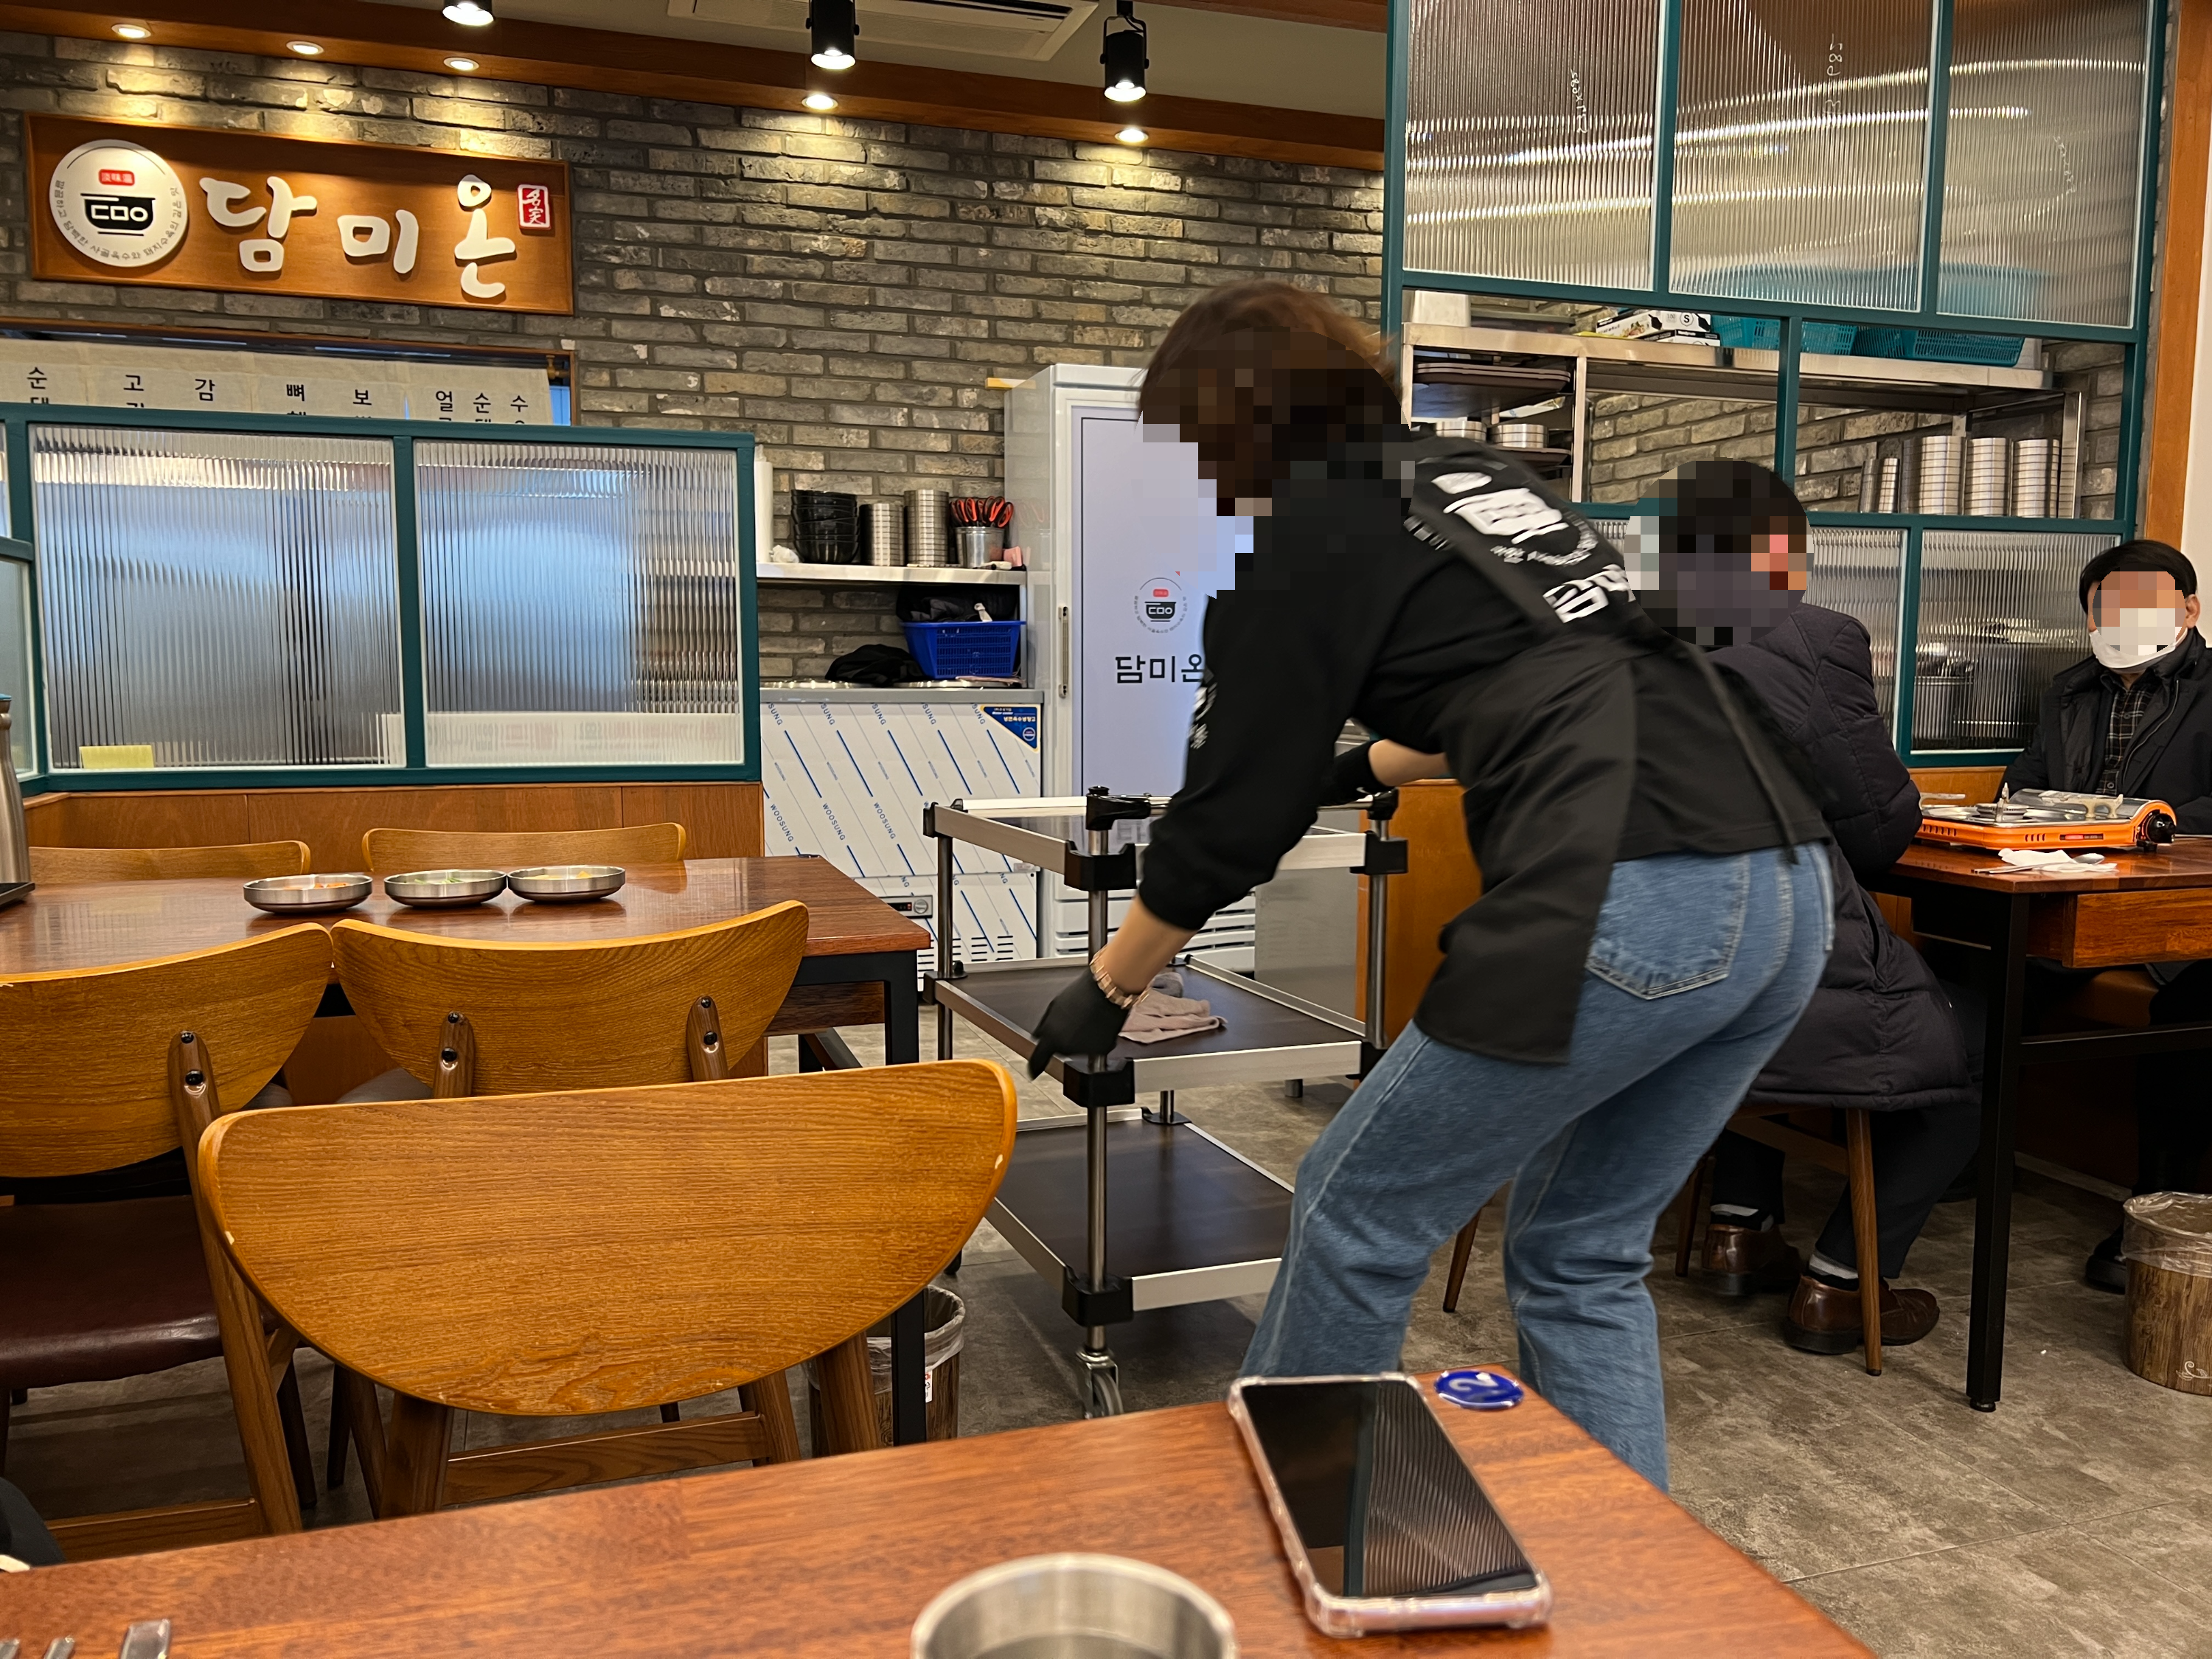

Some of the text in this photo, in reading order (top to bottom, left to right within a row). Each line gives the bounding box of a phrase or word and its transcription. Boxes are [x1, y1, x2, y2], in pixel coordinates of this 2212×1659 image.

[199, 174, 516, 299] 담미온
[1683, 314, 1690, 323] S
[195, 378, 216, 402] 감
[1115, 654, 1205, 684] 담미온
[768, 703, 783, 726] SUNG
[821, 703, 835, 726] SUNG
[872, 703, 887, 726] SUNG
[922, 703, 936, 725] SUNG
[972, 703, 986, 725] SUNG
[770, 804, 794, 843] WOOSUNG
[822, 802, 846, 841] WOOSUNG
[873, 801, 896, 840] WOOSUNG
